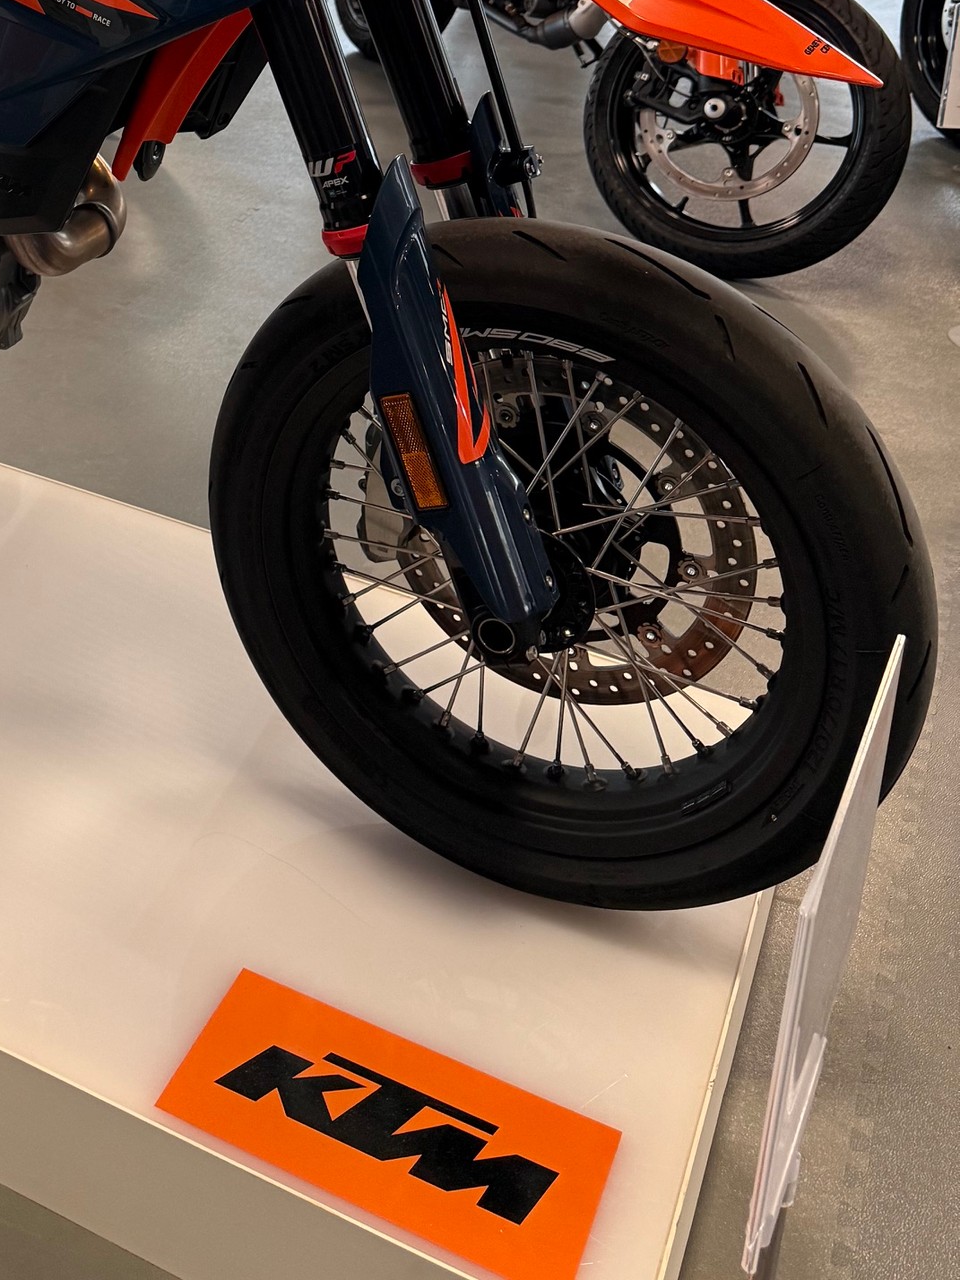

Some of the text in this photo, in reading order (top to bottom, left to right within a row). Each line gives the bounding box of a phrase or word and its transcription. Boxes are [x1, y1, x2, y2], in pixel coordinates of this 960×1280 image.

[66, 0, 76, 10] TO
[92, 13, 112, 27] RACE
[307, 149, 357, 178] WP
[322, 175, 350, 189] APEX
[518, 332, 617, 364] 690
[213, 1044, 560, 1227] KTM
